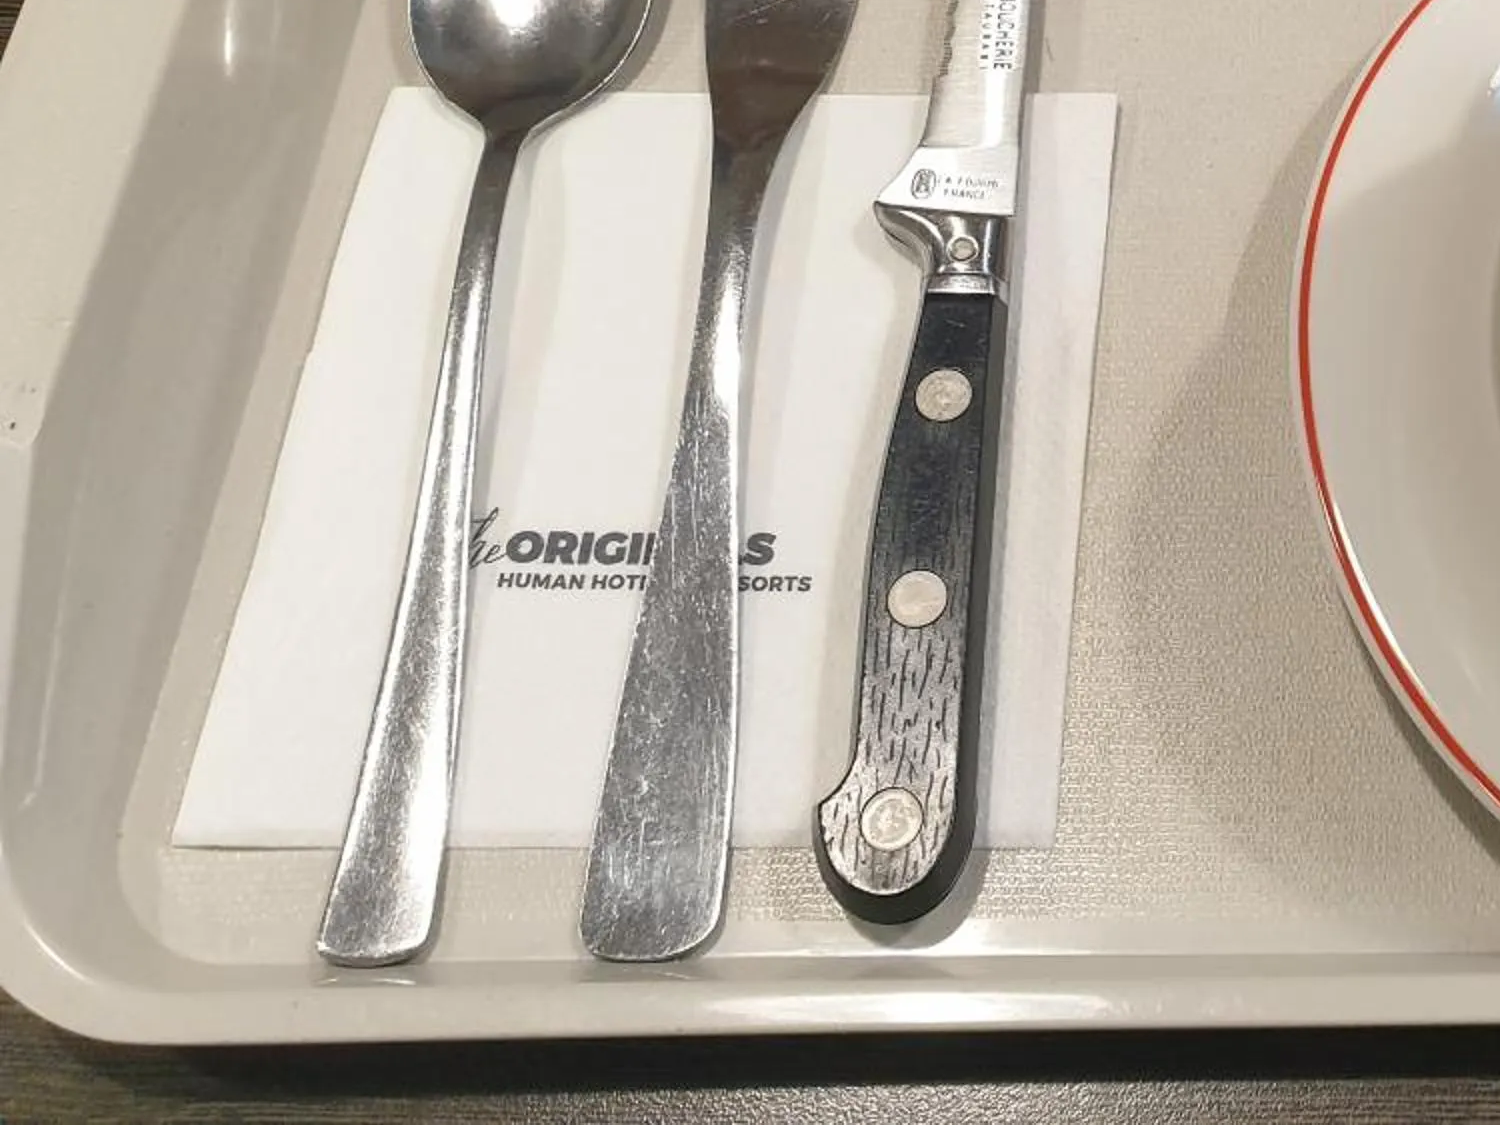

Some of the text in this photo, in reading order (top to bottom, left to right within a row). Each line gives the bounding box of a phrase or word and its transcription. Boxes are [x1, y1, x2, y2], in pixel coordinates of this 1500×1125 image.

[505, 531, 777, 567] ORIGIS
[497, 572, 812, 593] HUMAN HOT SORTS
